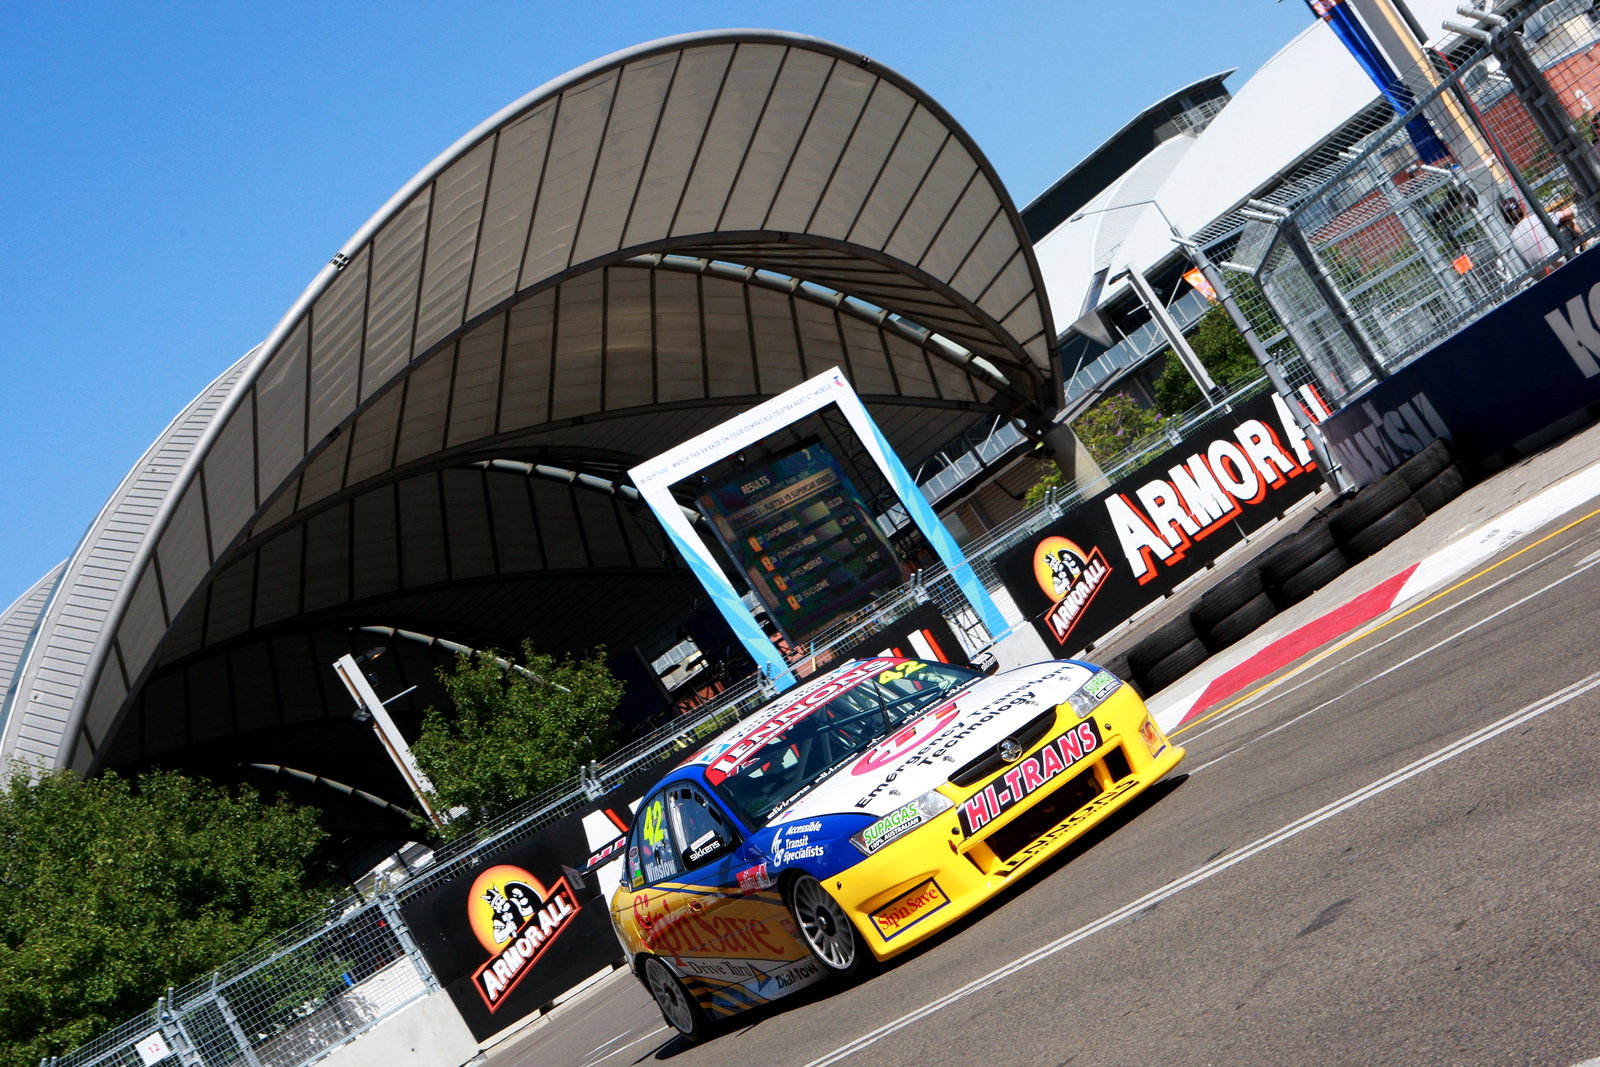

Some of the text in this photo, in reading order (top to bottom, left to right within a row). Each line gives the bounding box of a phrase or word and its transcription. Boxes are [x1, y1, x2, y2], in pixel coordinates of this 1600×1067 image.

[729, 427, 744, 439] YOUR
[740, 474, 771, 496] RESULTS
[790, 480, 816, 498] SUPERCAR
[877, 660, 928, 685] 42
[855, 721, 965, 809] Emergency
[966, 664, 1076, 719] Transport
[918, 690, 1037, 767] Technology
[965, 721, 1098, 833] HI-TRANS
[643, 800, 664, 846] 42
[785, 820, 823, 836] Accessible
[863, 803, 918, 845] SUPAGAS
[870, 816, 920, 850] 100% AUSTRALIAN
[689, 840, 721, 862] sikkens
[785, 835, 809, 850] Transit
[783, 845, 825, 865] Specialists
[645, 859, 678, 882] Winslow
[906, 888, 939, 912] Save
[697, 907, 785, 955] Save
[688, 961, 755, 977] Drive Thru
[148, 1043, 161, 1054] 12
